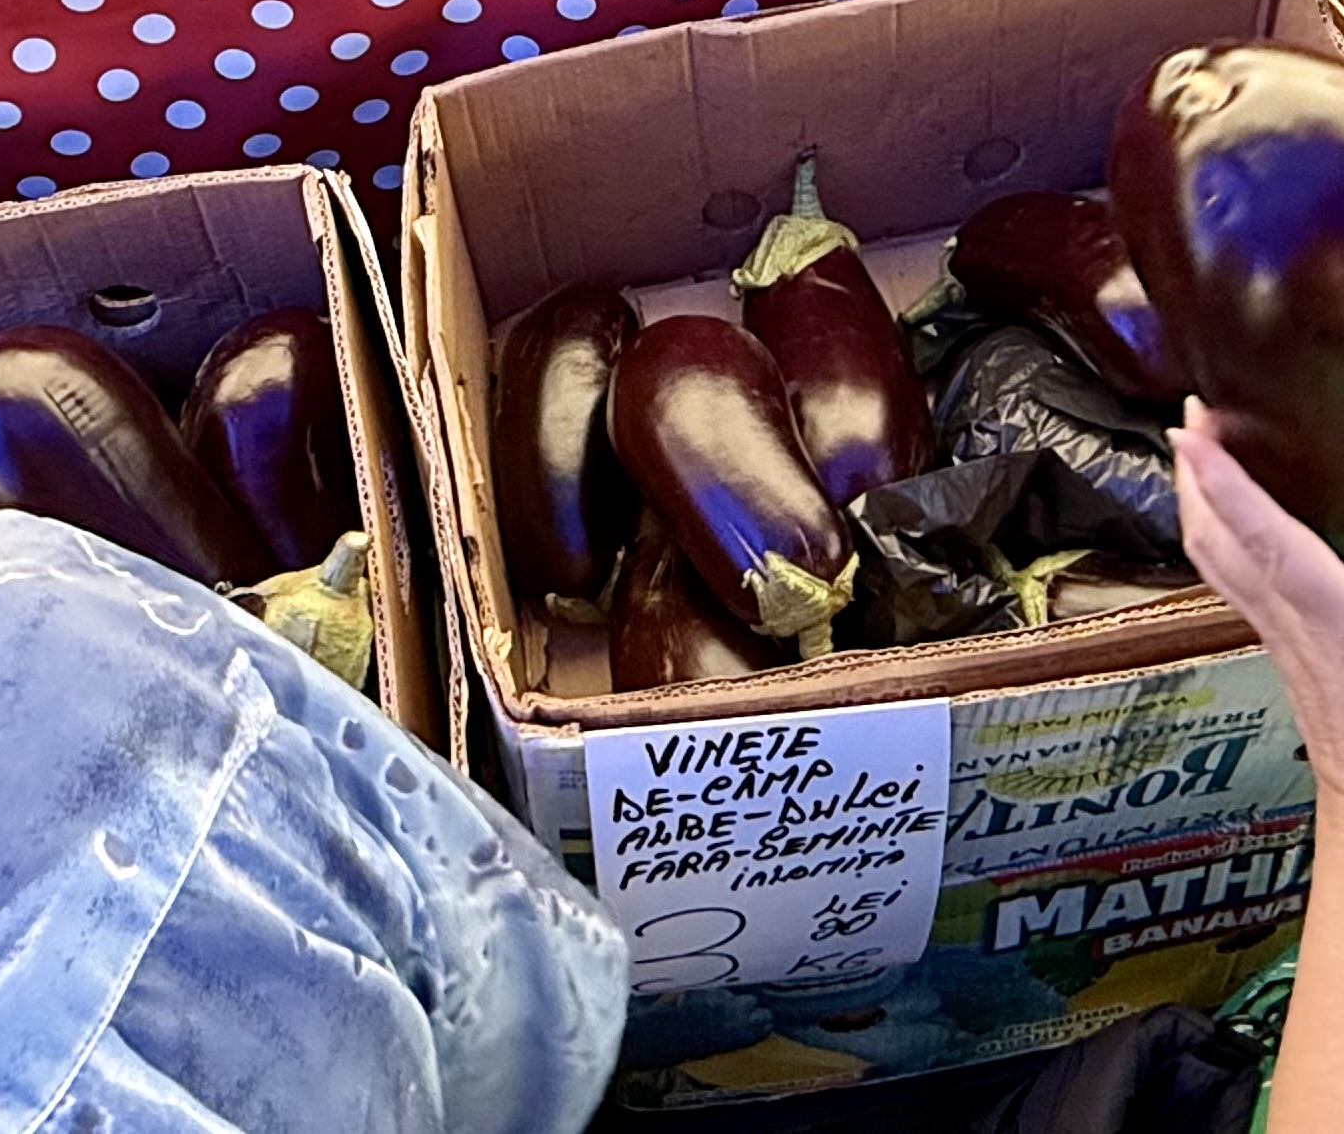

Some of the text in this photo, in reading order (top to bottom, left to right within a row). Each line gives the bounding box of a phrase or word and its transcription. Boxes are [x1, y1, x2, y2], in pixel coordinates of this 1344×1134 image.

[953, 706, 1269, 774] PREMIUM BANAN
[1003, 713, 1072, 736] PACK
[993, 845, 1312, 952] MATHI
